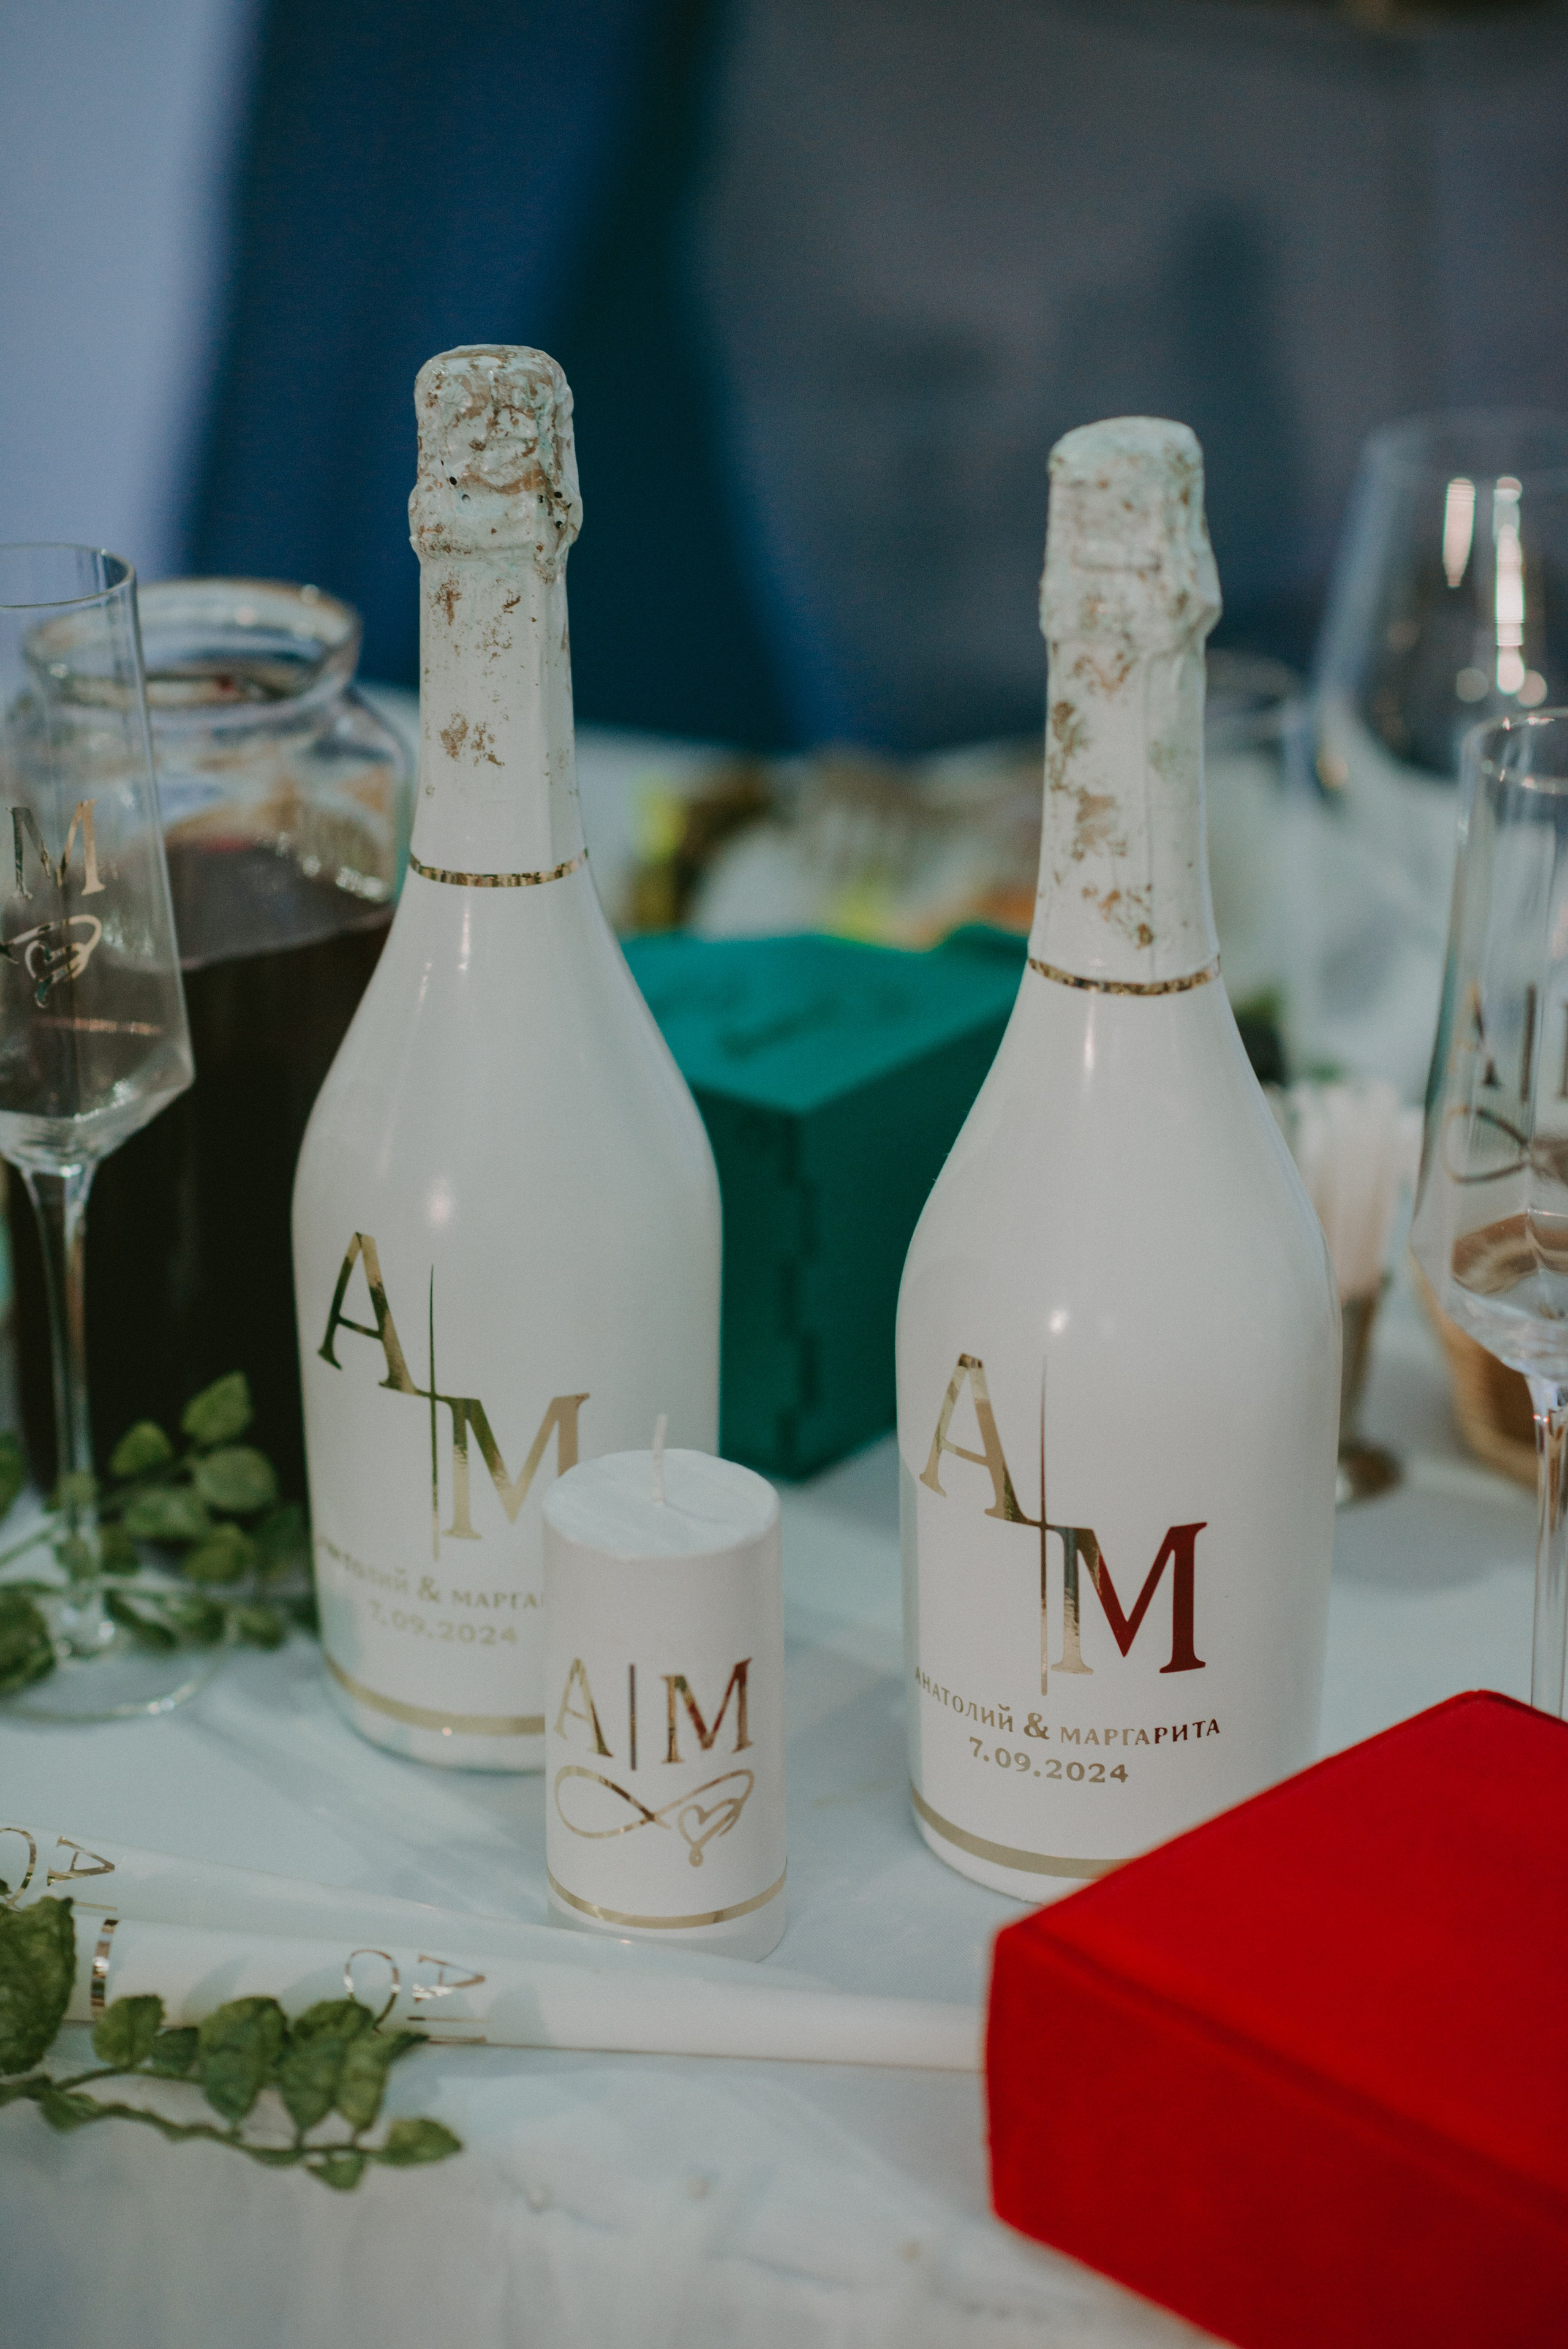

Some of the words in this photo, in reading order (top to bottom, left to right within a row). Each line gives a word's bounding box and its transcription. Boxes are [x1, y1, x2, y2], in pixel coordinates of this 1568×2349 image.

[418, 1575, 440, 1603] &
[451, 1589, 544, 1610] МАРГА
[369, 1597, 519, 1646] 7.09.2024
[914, 1665, 1014, 1733] АНАТОЛИЙ
[1023, 1712, 1050, 1740] &
[1060, 1718, 1221, 1746] МАРГАРИТА
[968, 1736, 1129, 1784] 7.09.2024
